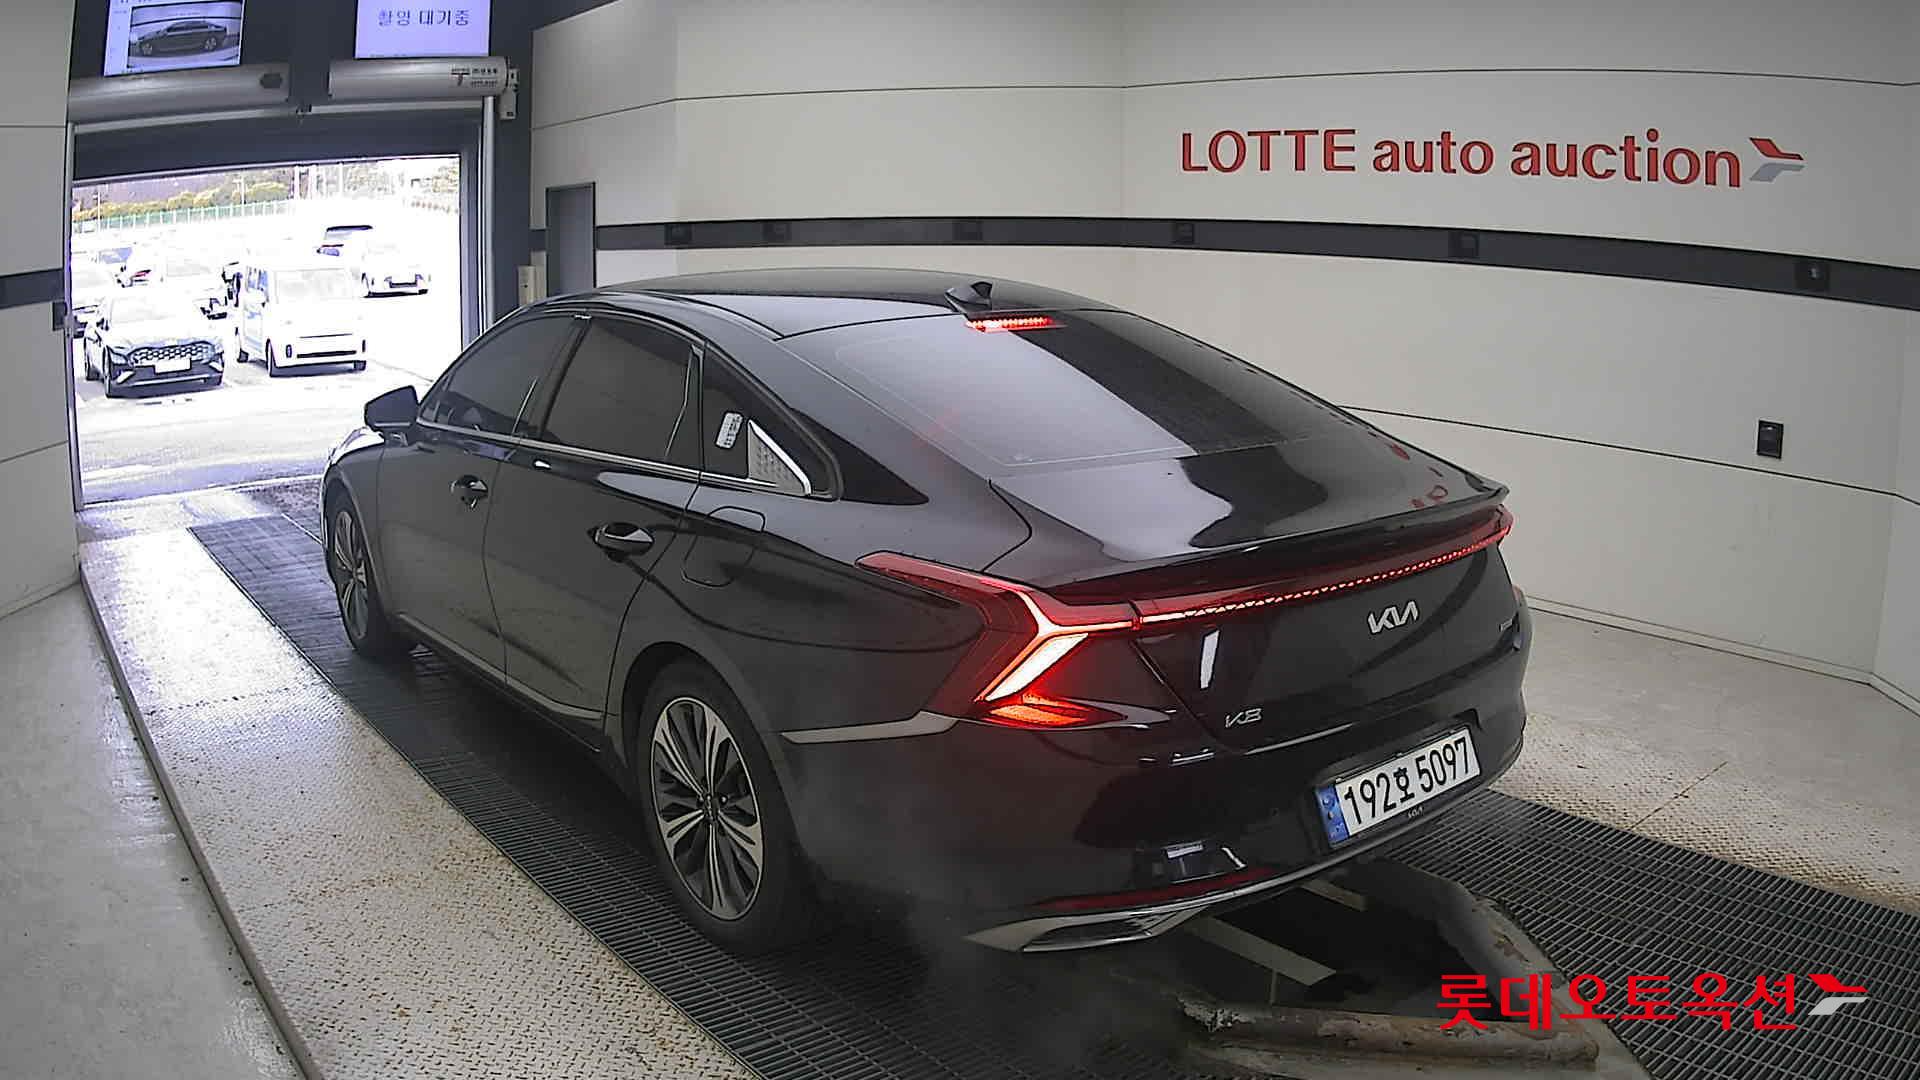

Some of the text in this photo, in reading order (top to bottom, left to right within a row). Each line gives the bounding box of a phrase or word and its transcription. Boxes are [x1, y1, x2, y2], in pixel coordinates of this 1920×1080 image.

[419, 9, 469, 27] 대기중
[1181, 128, 1741, 188] LOTTE auto auction
[1225, 708, 1262, 727] K8
[1344, 737, 1469, 824] 192호 5097
